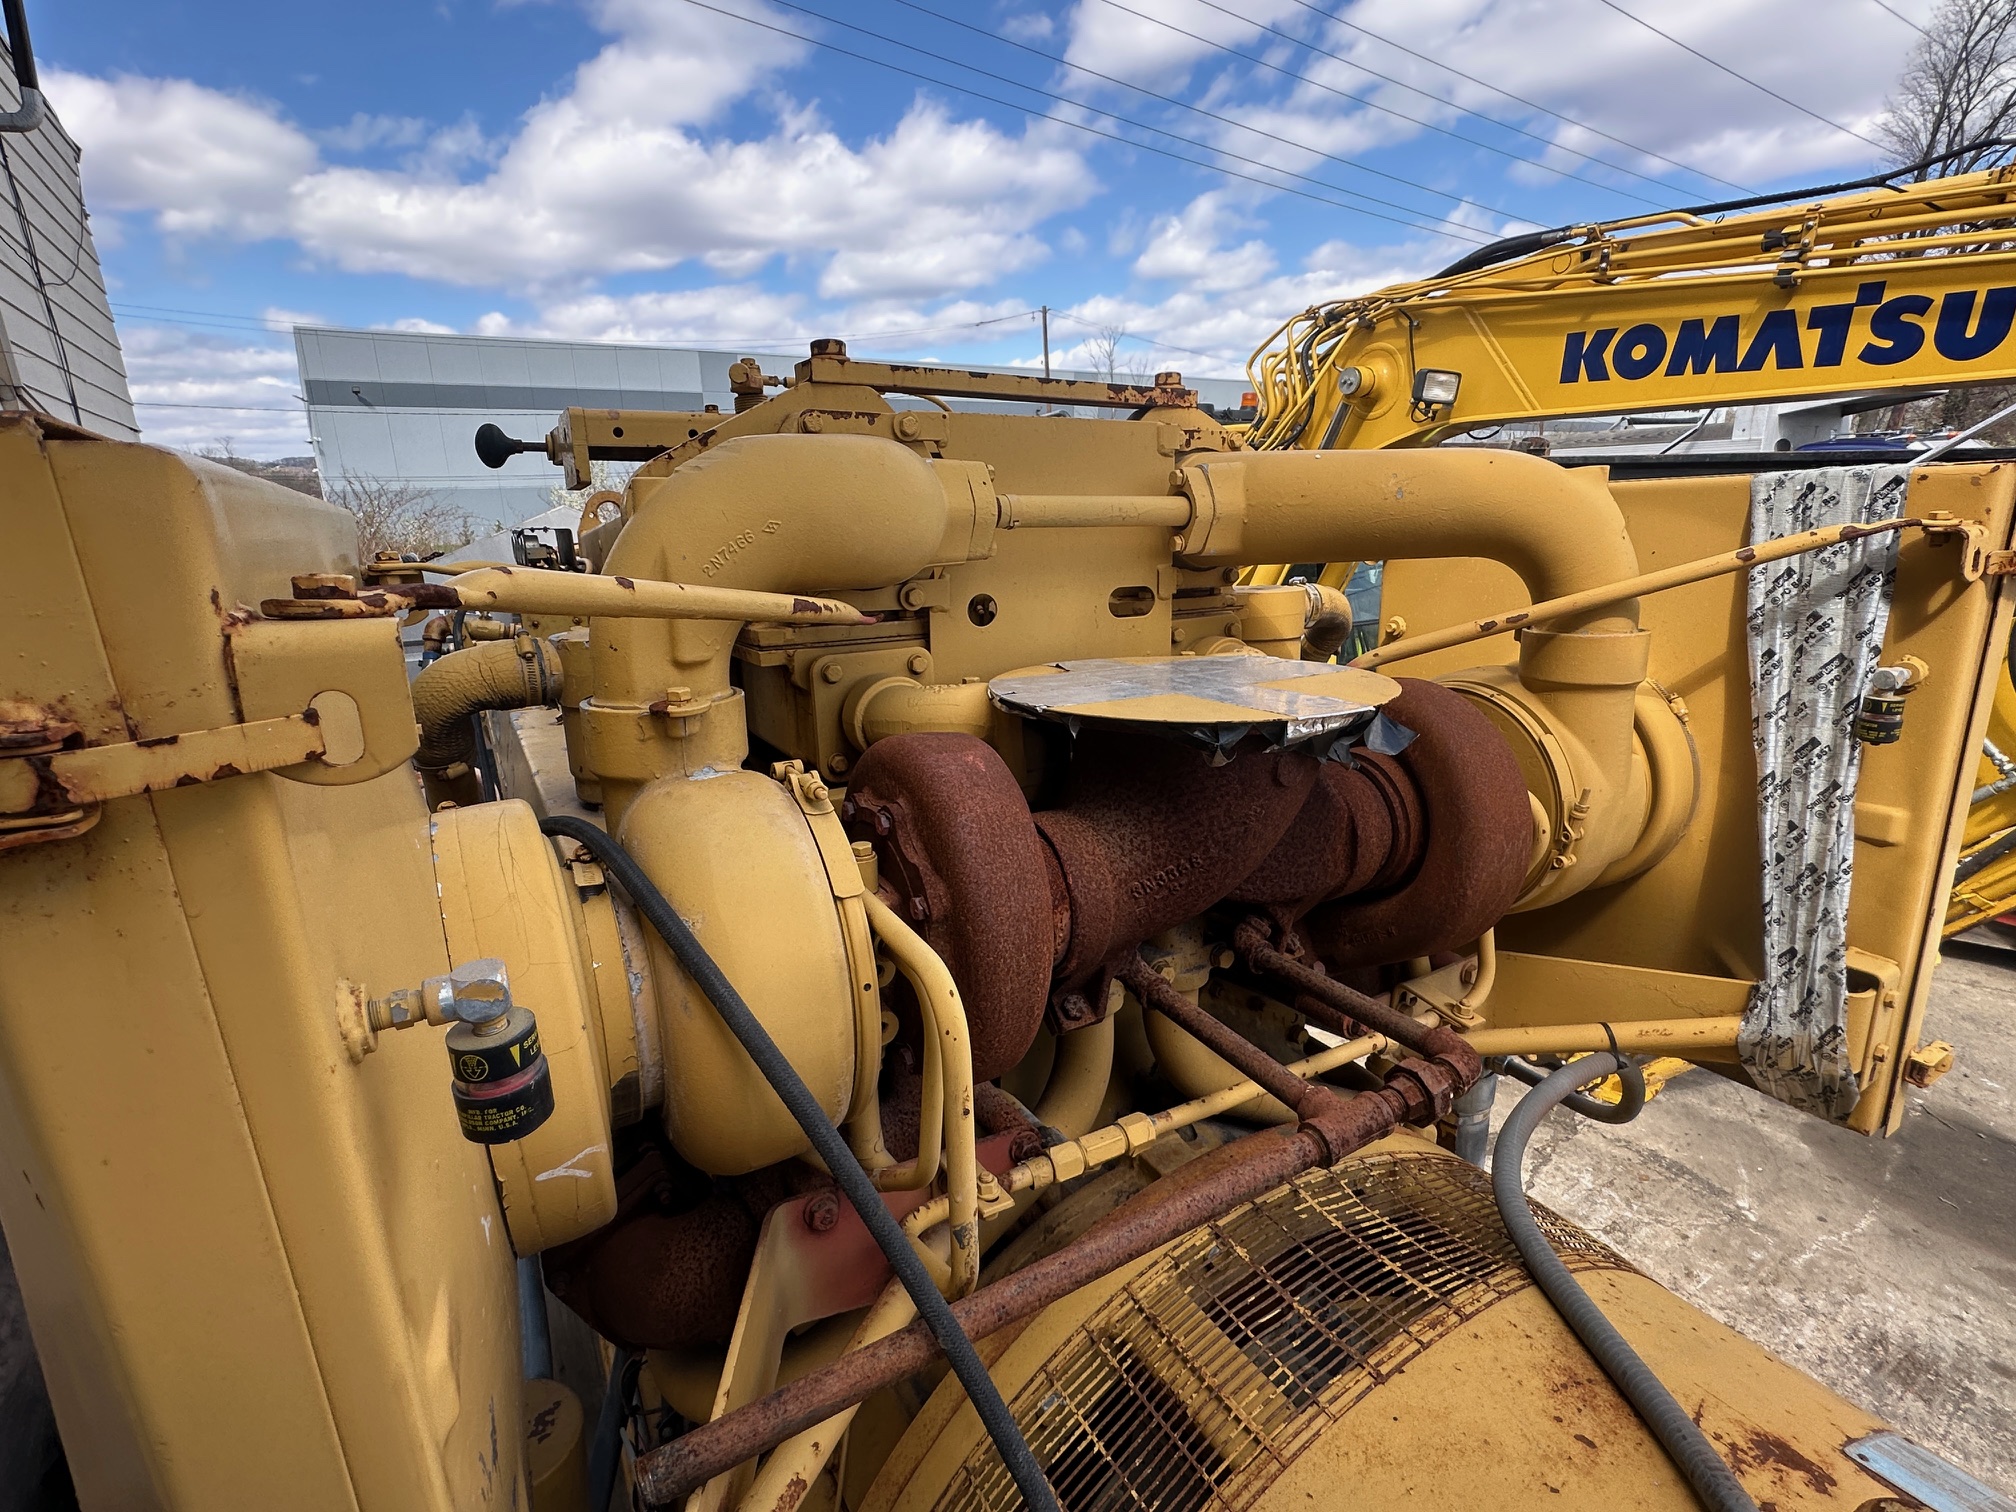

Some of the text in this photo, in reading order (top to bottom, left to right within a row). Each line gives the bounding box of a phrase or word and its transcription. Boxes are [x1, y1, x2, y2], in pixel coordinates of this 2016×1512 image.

[1560, 280, 2016, 384] KOMATSU
[702, 529, 756, 579] 2N7466
[1804, 631, 1817, 644] PC
[1816, 617, 1835, 632] 857
[1806, 657, 1841, 686] Shurtape
[1813, 870, 1828, 887] 857
[484, 1109, 514, 1120] TRACTOR
